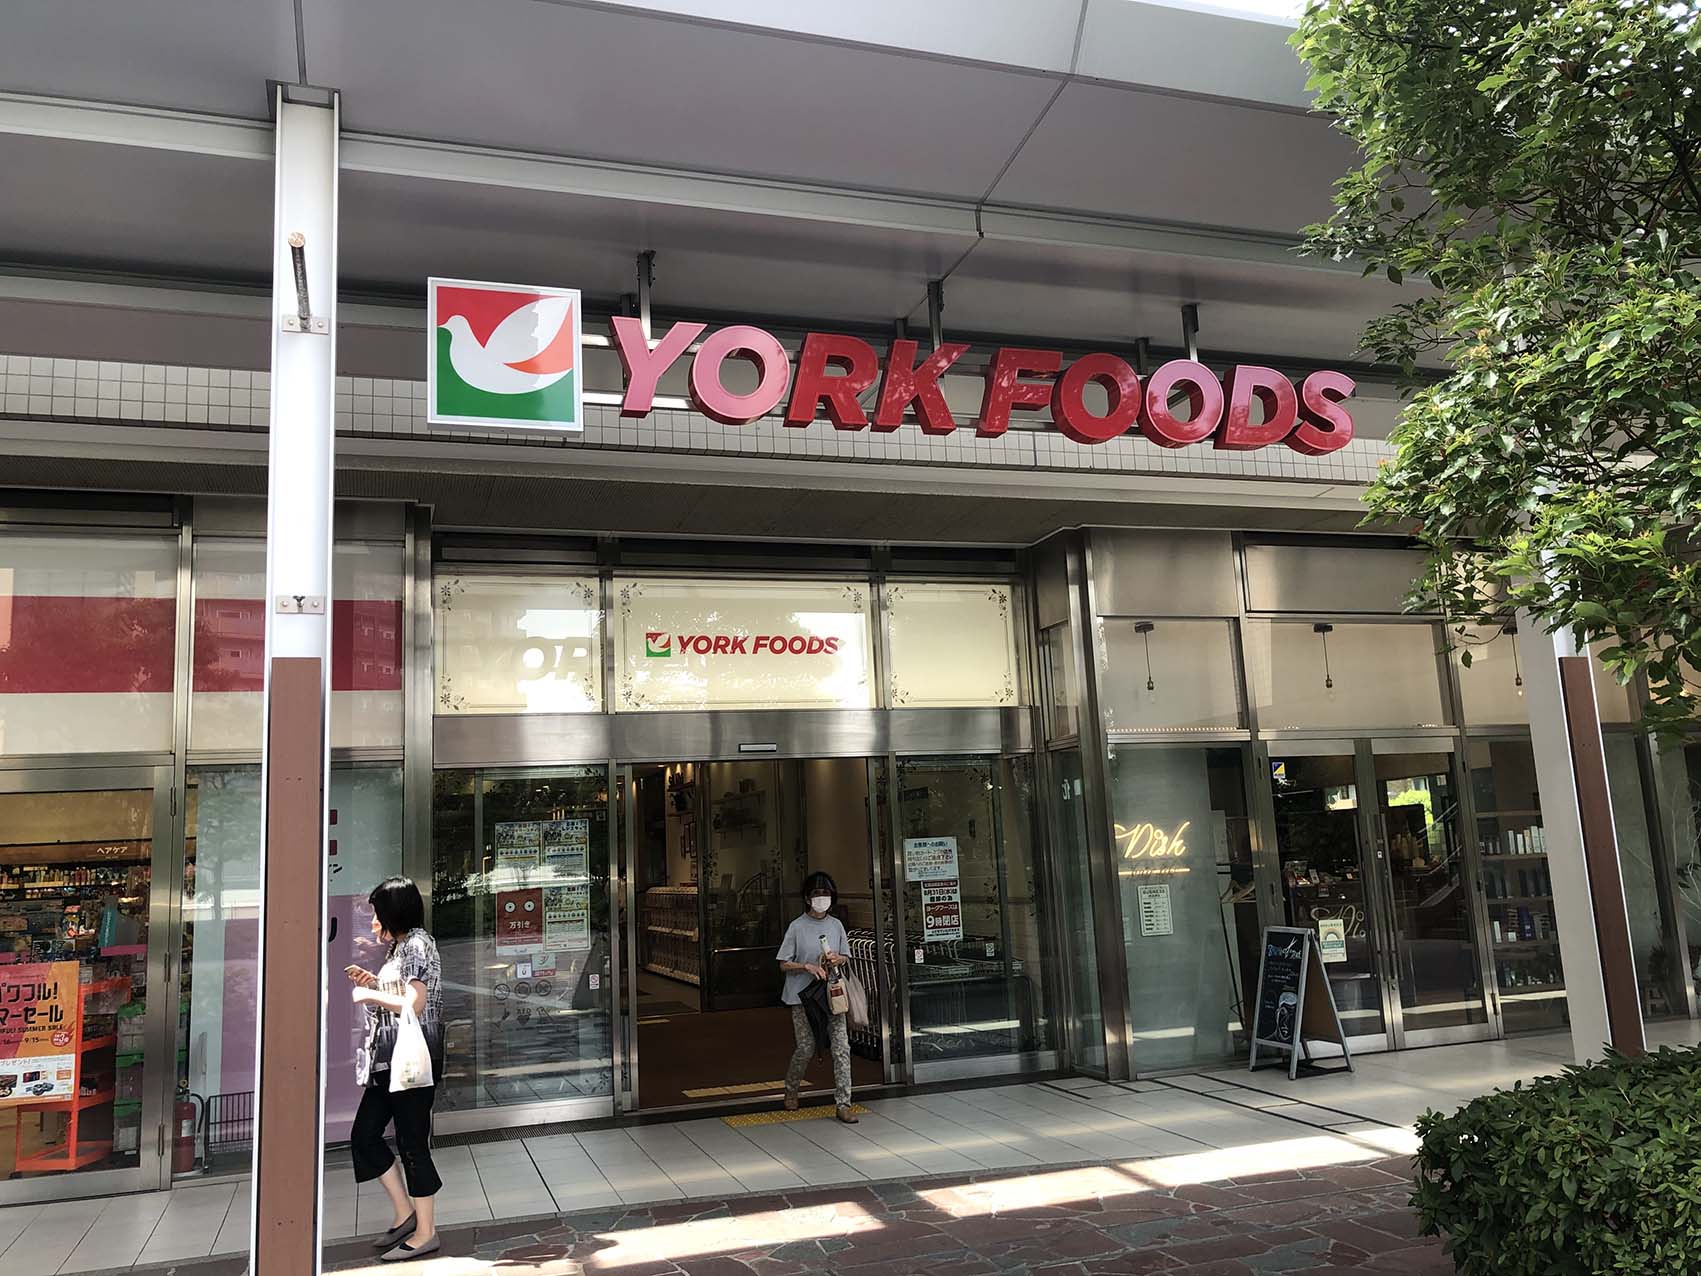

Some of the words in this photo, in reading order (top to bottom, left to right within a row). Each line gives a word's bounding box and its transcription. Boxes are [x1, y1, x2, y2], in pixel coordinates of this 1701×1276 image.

[609, 315, 970, 436] YORK
[977, 346, 1357, 456] FOODS
[678, 634, 748, 655] YORK
[753, 635, 839, 656] FOODS
[96, 846, 128, 855] ヘアケア
[926, 914, 960, 928] 9時閉店
